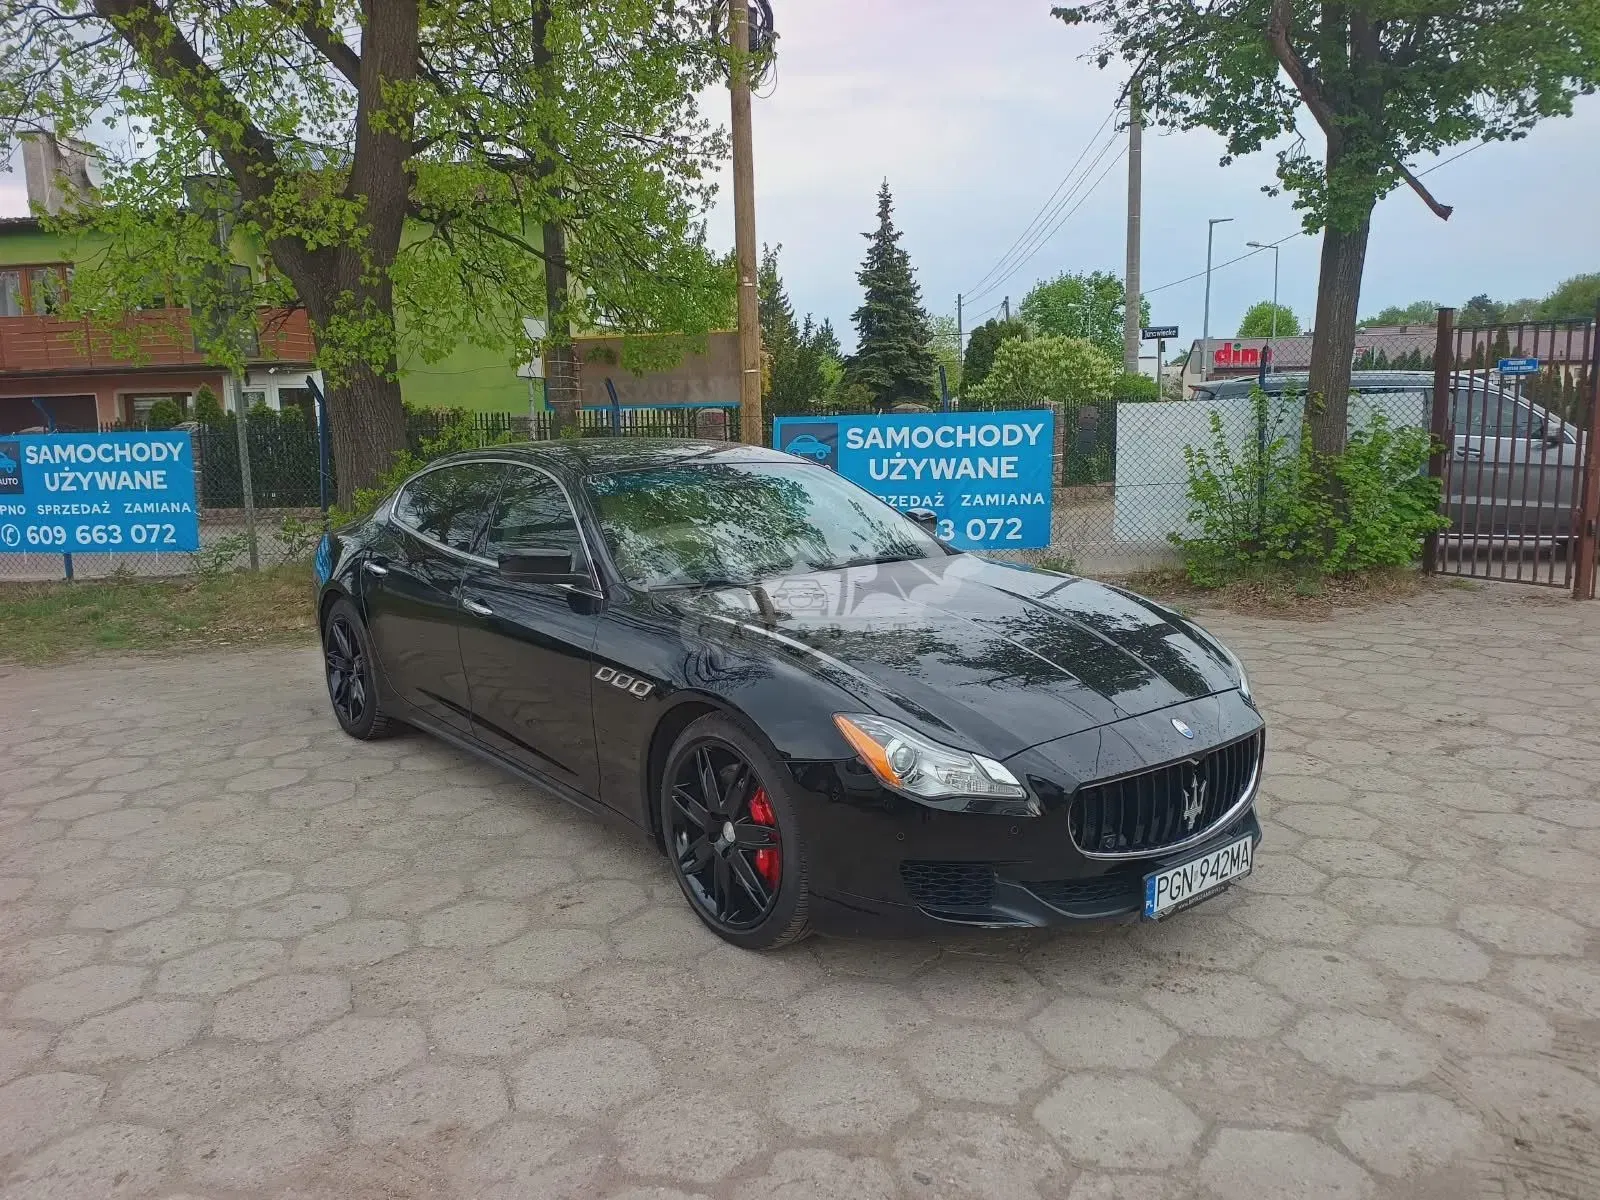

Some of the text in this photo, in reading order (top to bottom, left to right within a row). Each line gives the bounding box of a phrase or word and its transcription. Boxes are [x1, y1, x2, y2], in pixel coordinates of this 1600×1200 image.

[845, 423, 1045, 449] SAMOCHODY
[25, 441, 184, 465] SAMOCHODY
[869, 452, 1019, 480] UŻYWANE
[44, 466, 168, 492] UŻYWANE
[0, 501, 192, 516] PNO SPRZEDAŻ ZAMIANA
[879, 491, 1045, 507] RZEDAŻ ZAMIANA
[26, 523, 177, 545] 609 663 072
[966, 517, 1023, 541] 072
[1156, 864, 1194, 908] PGN
[1198, 840, 1249, 889] 942MA
